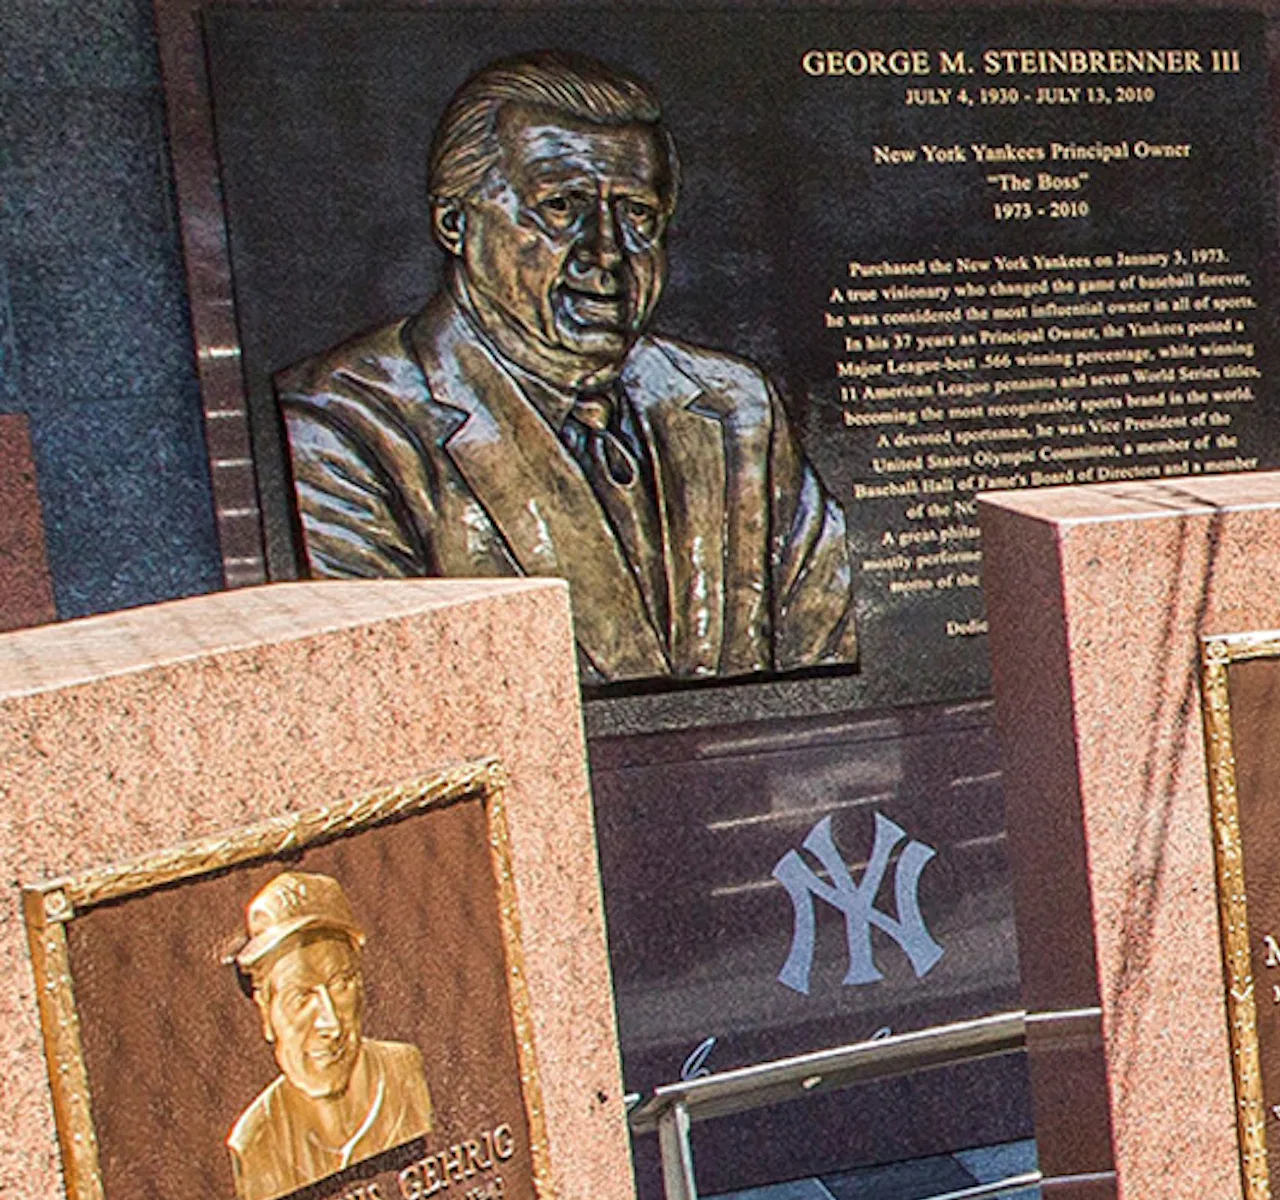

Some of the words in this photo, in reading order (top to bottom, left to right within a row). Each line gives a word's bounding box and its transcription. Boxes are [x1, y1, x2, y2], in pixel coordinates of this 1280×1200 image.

[802, 51, 931, 76] GEORGE
[939, 51, 975, 75] M.
[983, 50, 1203, 74] STEINBRENNER
[1211, 51, 1240, 73] III
[905, 88, 951, 105] JULY
[980, 87, 1019, 104] 1930
[1036, 87, 1081, 104] JULY
[1087, 86, 1112, 104] 13,
[1116, 86, 1155, 103] 2010
[872, 145, 916, 164] New
[921, 144, 967, 162] York
[971, 143, 1046, 162] Yankees
[1052, 141, 1130, 163] Principal
[1134, 141, 1192, 159] Owner
[987, 173, 1032, 191] "The
[1038, 171, 1089, 191] Boss"
[994, 203, 1032, 220] 1973
[1051, 202, 1088, 218] 2010
[849, 260, 926, 277] Purchased
[929, 259, 952, 274] the
[957, 257, 991, 273] New
[995, 255, 1029, 271] York
[1034, 254, 1091, 270] Yankees
[1094, 256, 1113, 268] on
[1117, 252, 1169, 268] January
[830, 287, 844, 302] A
[847, 289, 877, 301] true
[882, 285, 950, 301] visionary
[954, 282, 986, 297] who
[989, 280, 1048, 298] changed
[1052, 279, 1075, 293] the
[1079, 280, 1115, 294] game
[1119, 275, 1136, 290] of
[1138, 273, 1194, 289] baseball
[771, 811, 945, 995] NY
